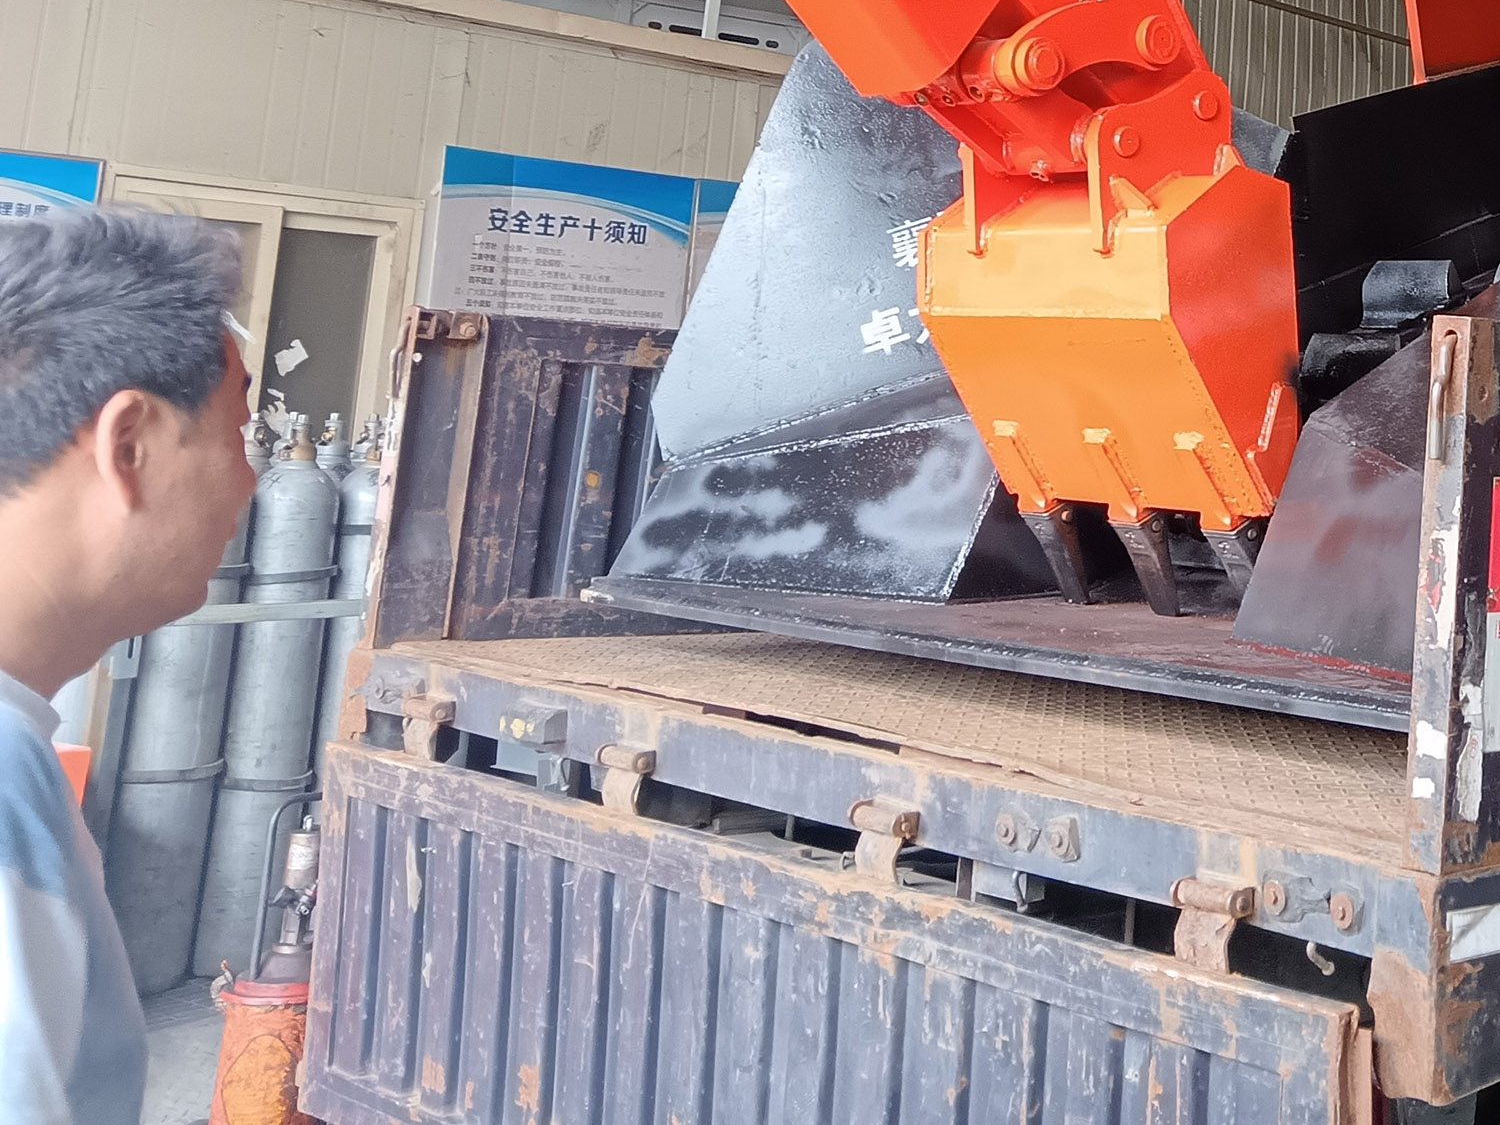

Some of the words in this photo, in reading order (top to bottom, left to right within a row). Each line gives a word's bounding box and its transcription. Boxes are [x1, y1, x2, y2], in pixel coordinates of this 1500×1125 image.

[487, 207, 648, 245] 安全生产十须知
[886, 211, 944, 271] 襄
[860, 306, 930, 355] 卓
